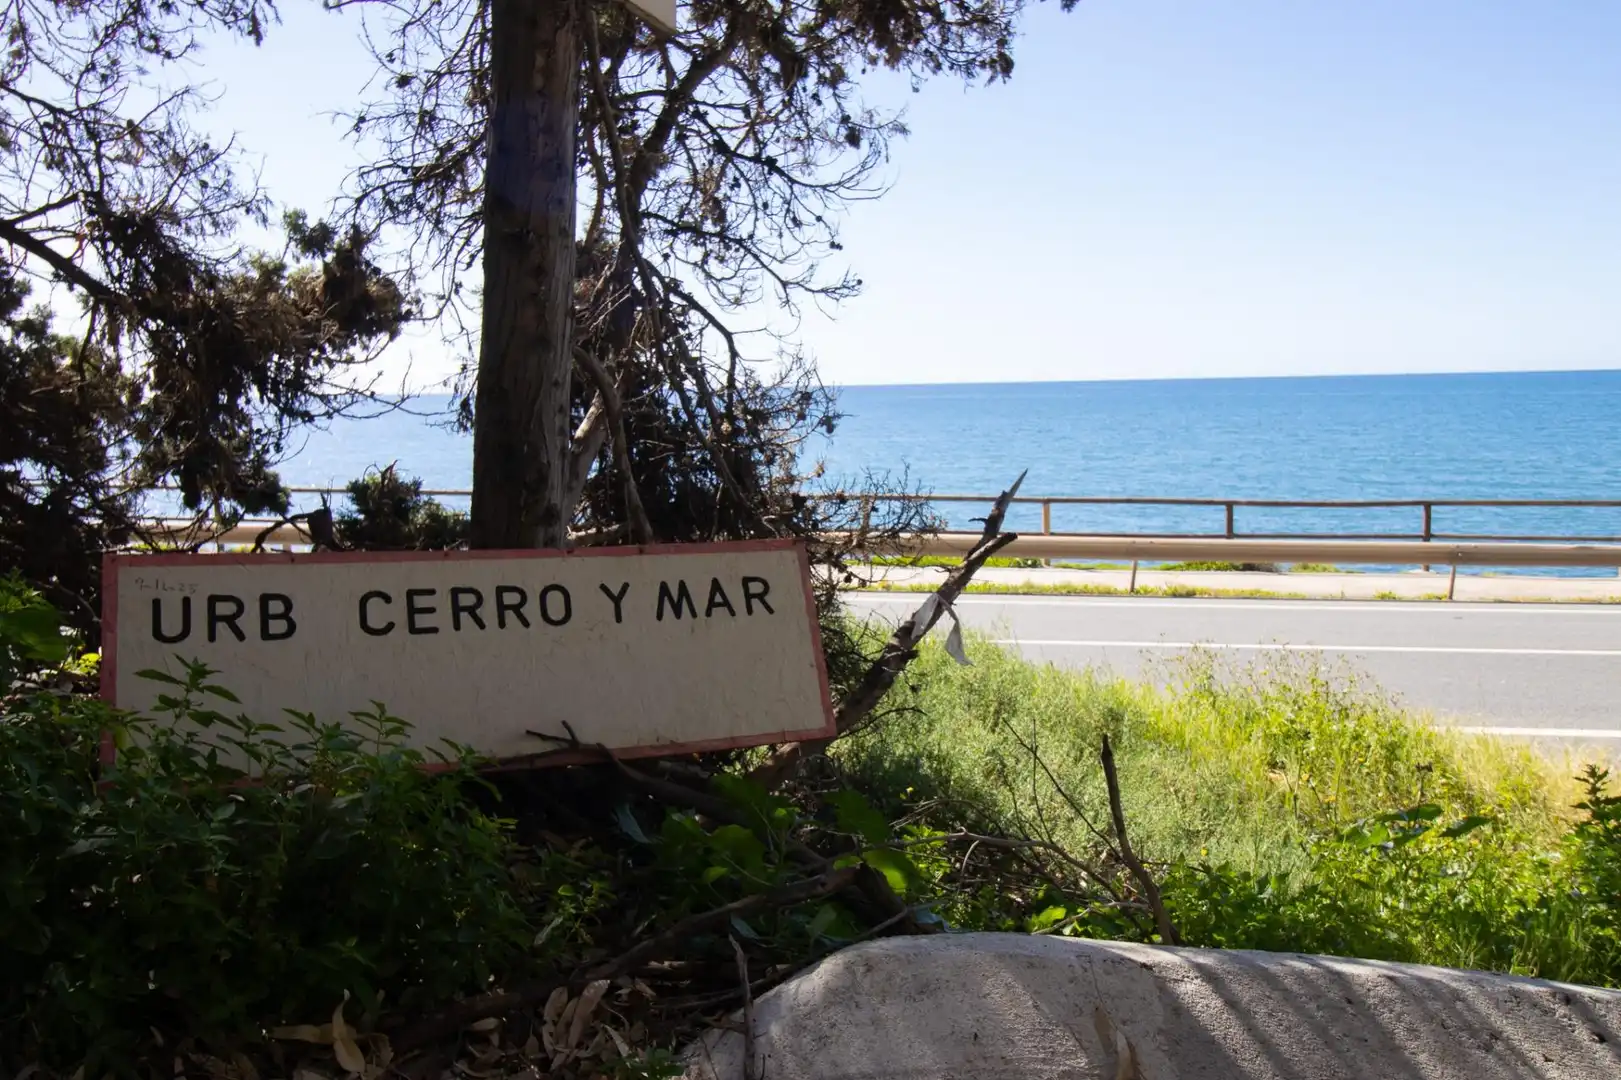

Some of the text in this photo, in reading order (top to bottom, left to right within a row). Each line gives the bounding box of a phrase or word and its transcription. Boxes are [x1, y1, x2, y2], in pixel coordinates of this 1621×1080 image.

[151, 575, 775, 645] URB CERRO Y MAR
